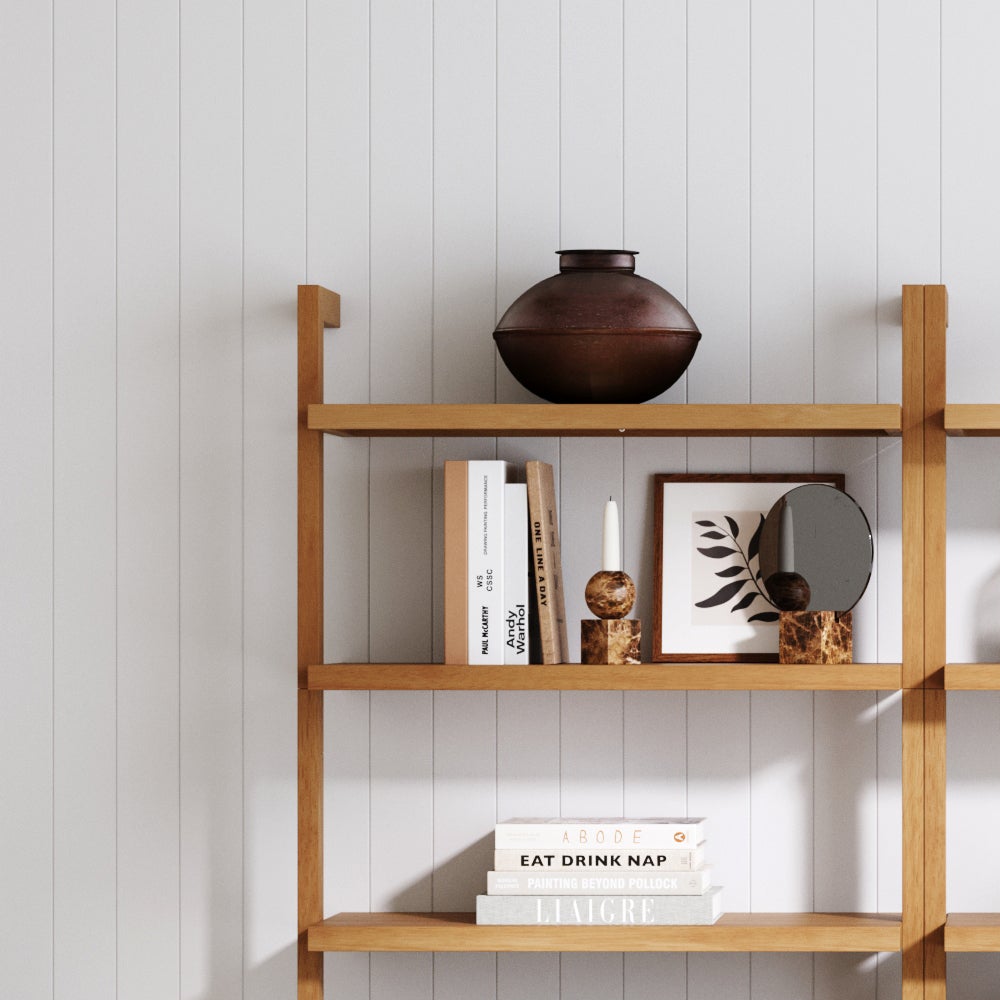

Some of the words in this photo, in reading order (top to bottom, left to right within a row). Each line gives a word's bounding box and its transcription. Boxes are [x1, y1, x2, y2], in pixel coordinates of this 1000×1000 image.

[533, 521, 542, 543] ONE
[536, 547, 544, 571] LINE
[476, 575, 484, 588] WS
[539, 585, 548, 607] DAY
[481, 606, 489, 638] McCARTHY
[506, 610, 518, 648] Andy
[516, 604, 526, 655] Warhol
[481, 639, 489, 655] PAUL
[562, 829, 643, 844] ABODE
[520, 854, 555, 867] EAT
[562, 854, 622, 867] DRINK
[627, 854, 668, 867] NAP
[527, 878, 578, 889] PAINTING
[581, 878, 625, 889] BEYOND
[629, 878, 678, 889] POLLOCK
